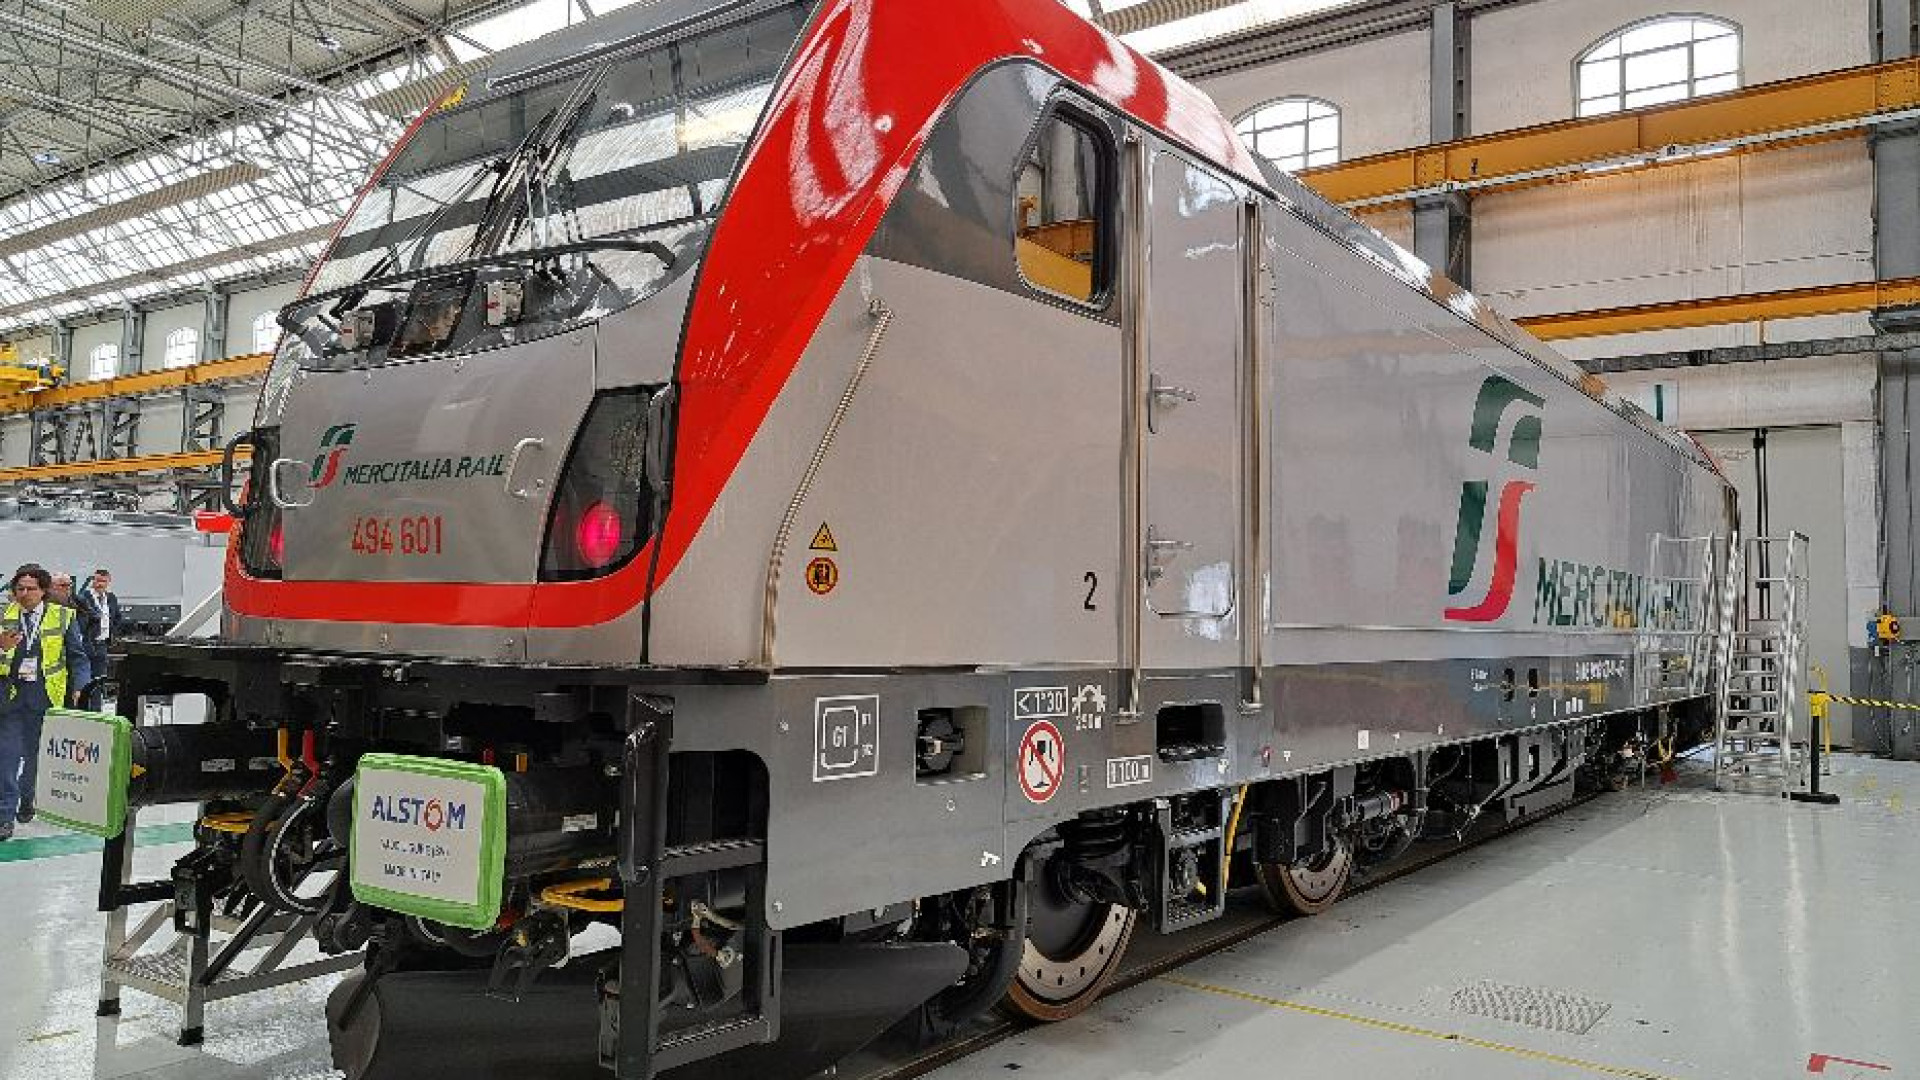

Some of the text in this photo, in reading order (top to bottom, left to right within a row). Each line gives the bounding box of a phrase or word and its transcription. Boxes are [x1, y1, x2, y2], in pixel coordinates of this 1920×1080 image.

[344, 454, 505, 485] MERCITALIA RAIL
[352, 515, 442, 555] 494 601
[1084, 571, 1098, 611] 2
[46, 737, 100, 764] ALSTOM
[371, 795, 466, 832] ALSTOM
